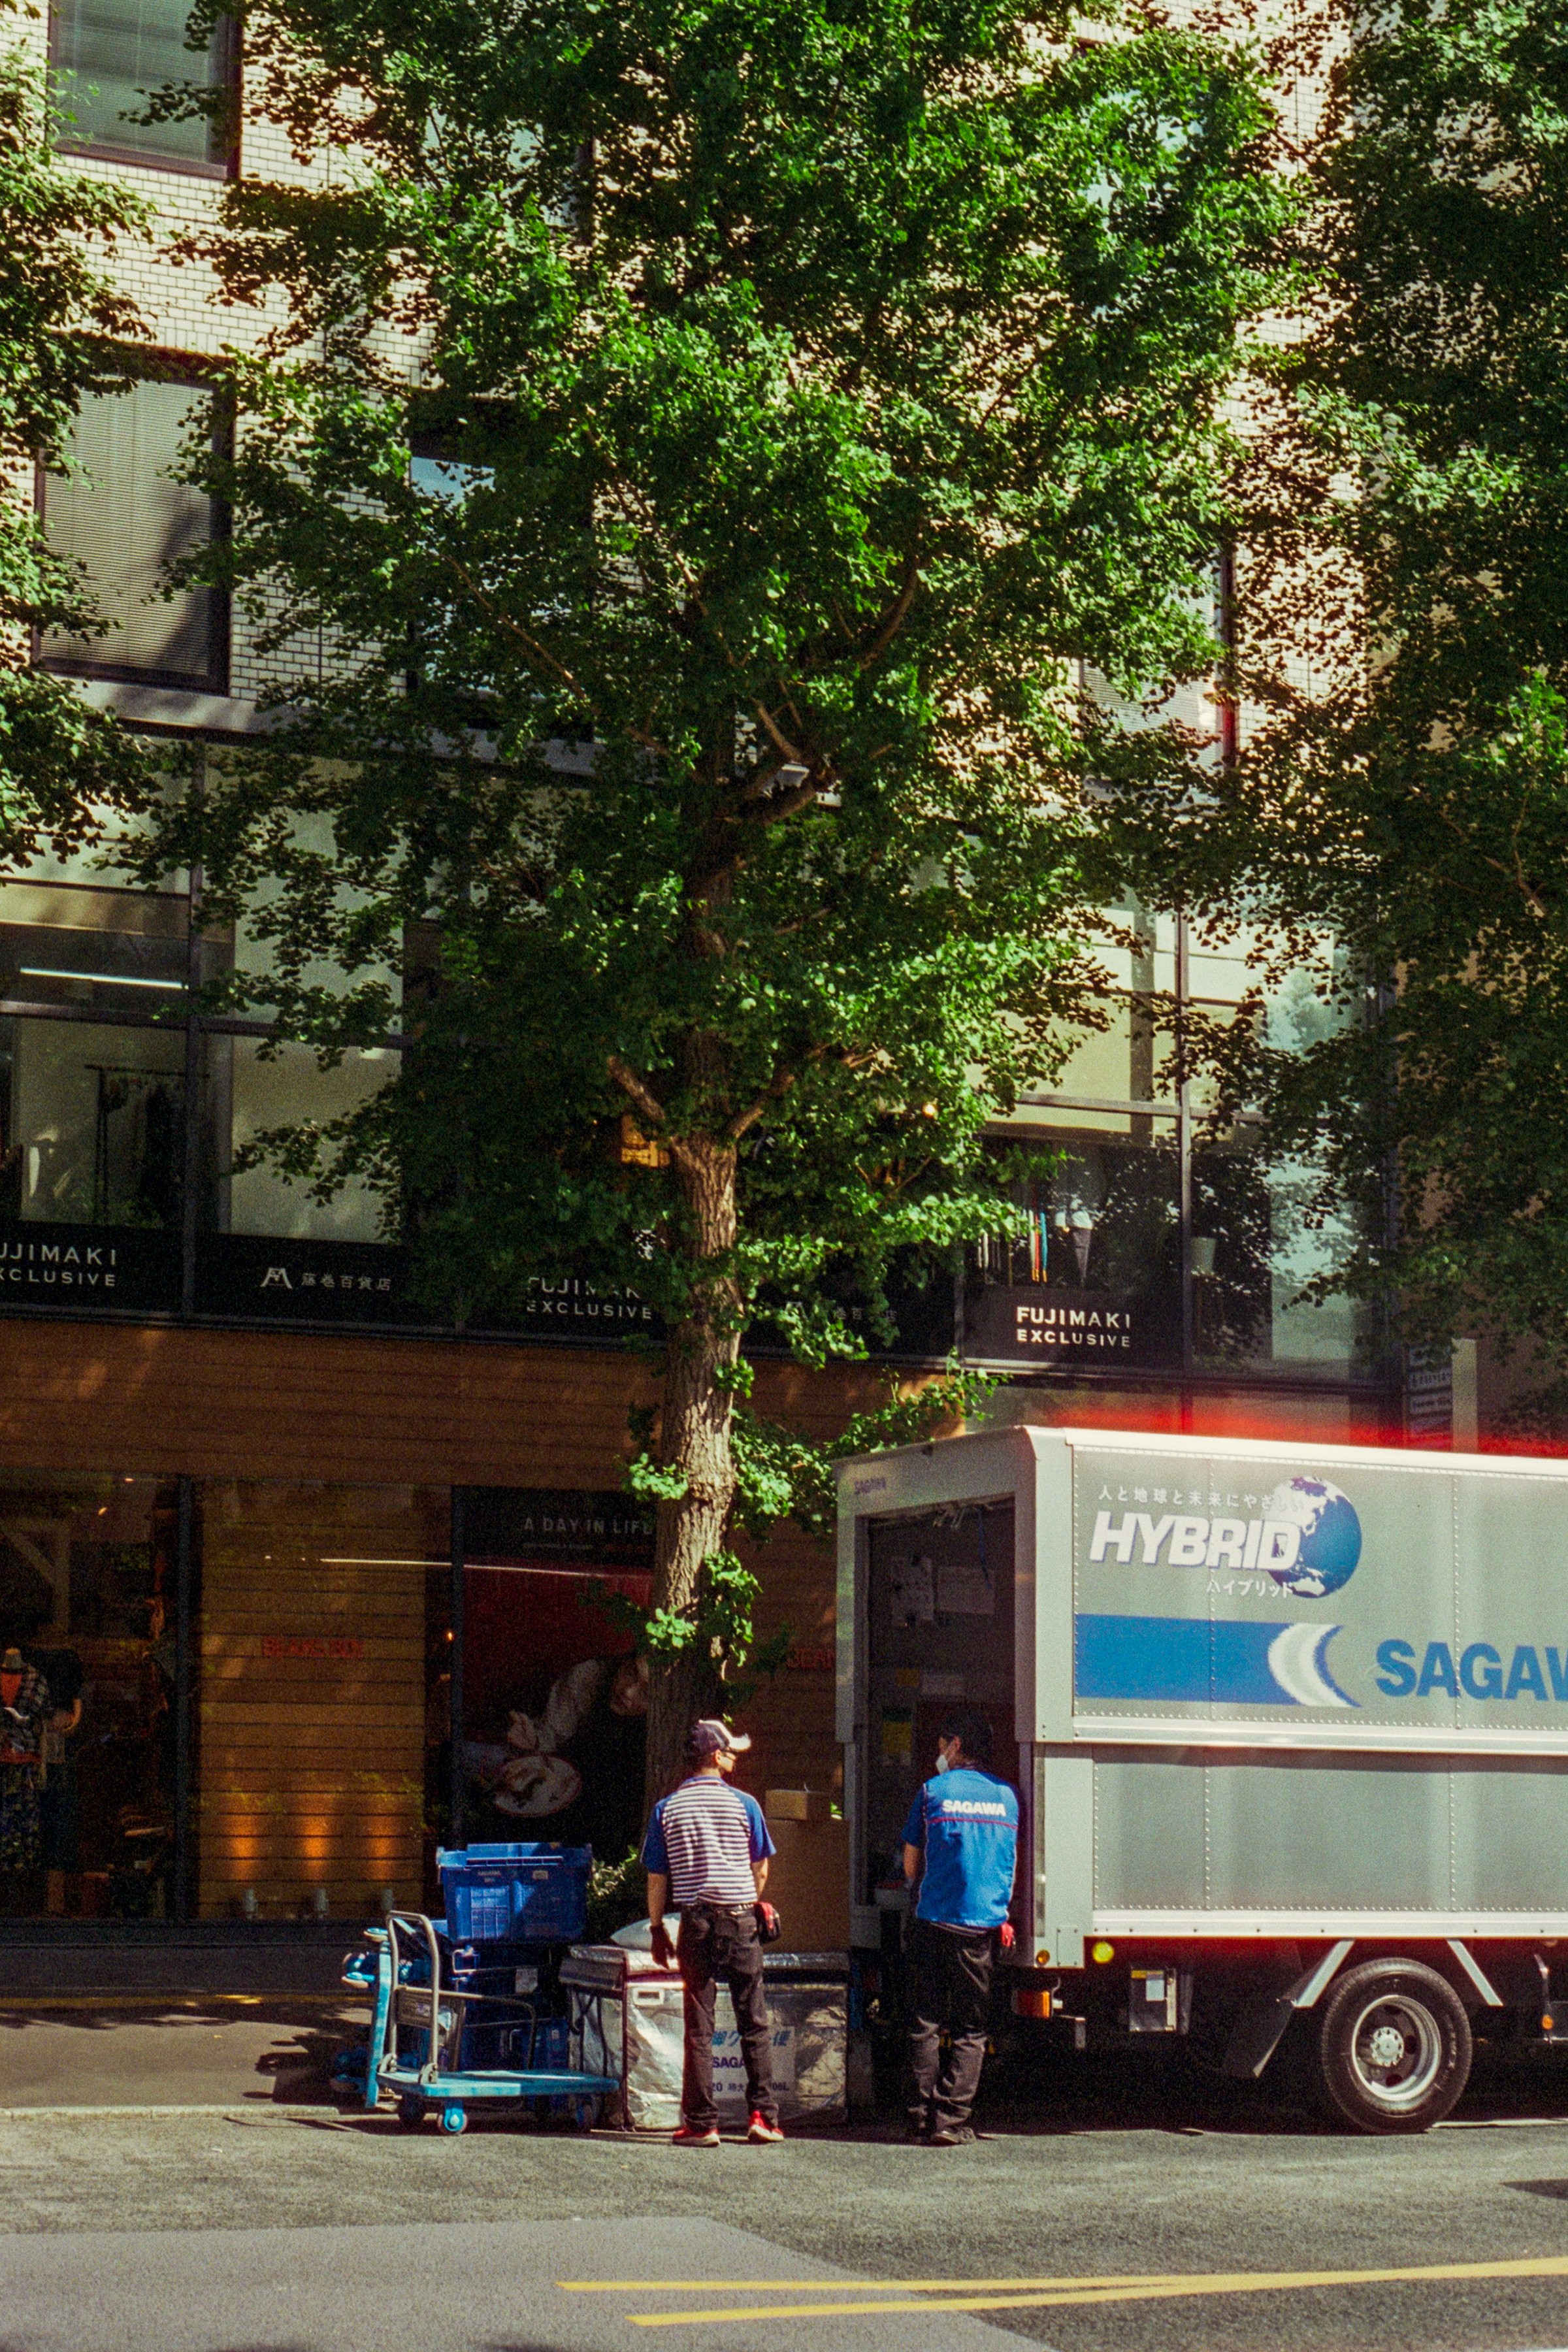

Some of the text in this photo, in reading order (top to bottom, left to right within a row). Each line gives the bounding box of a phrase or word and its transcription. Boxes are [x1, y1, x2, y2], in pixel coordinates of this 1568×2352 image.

[526, 1300, 652, 1320] EXCLUSIVE
[1016, 1306, 1131, 1329] FUJIMAKI
[1016, 1329, 1130, 1348] EXCLUSIVE
[524, 1516, 534, 1531] A
[542, 1516, 579, 1533] DAY
[586, 1518, 605, 1534] IN
[1089, 1511, 1302, 1571] HYBRID
[1206, 1578, 1294, 1599] ハイブリッド
[942, 1799, 1007, 1817] SAGAWA
